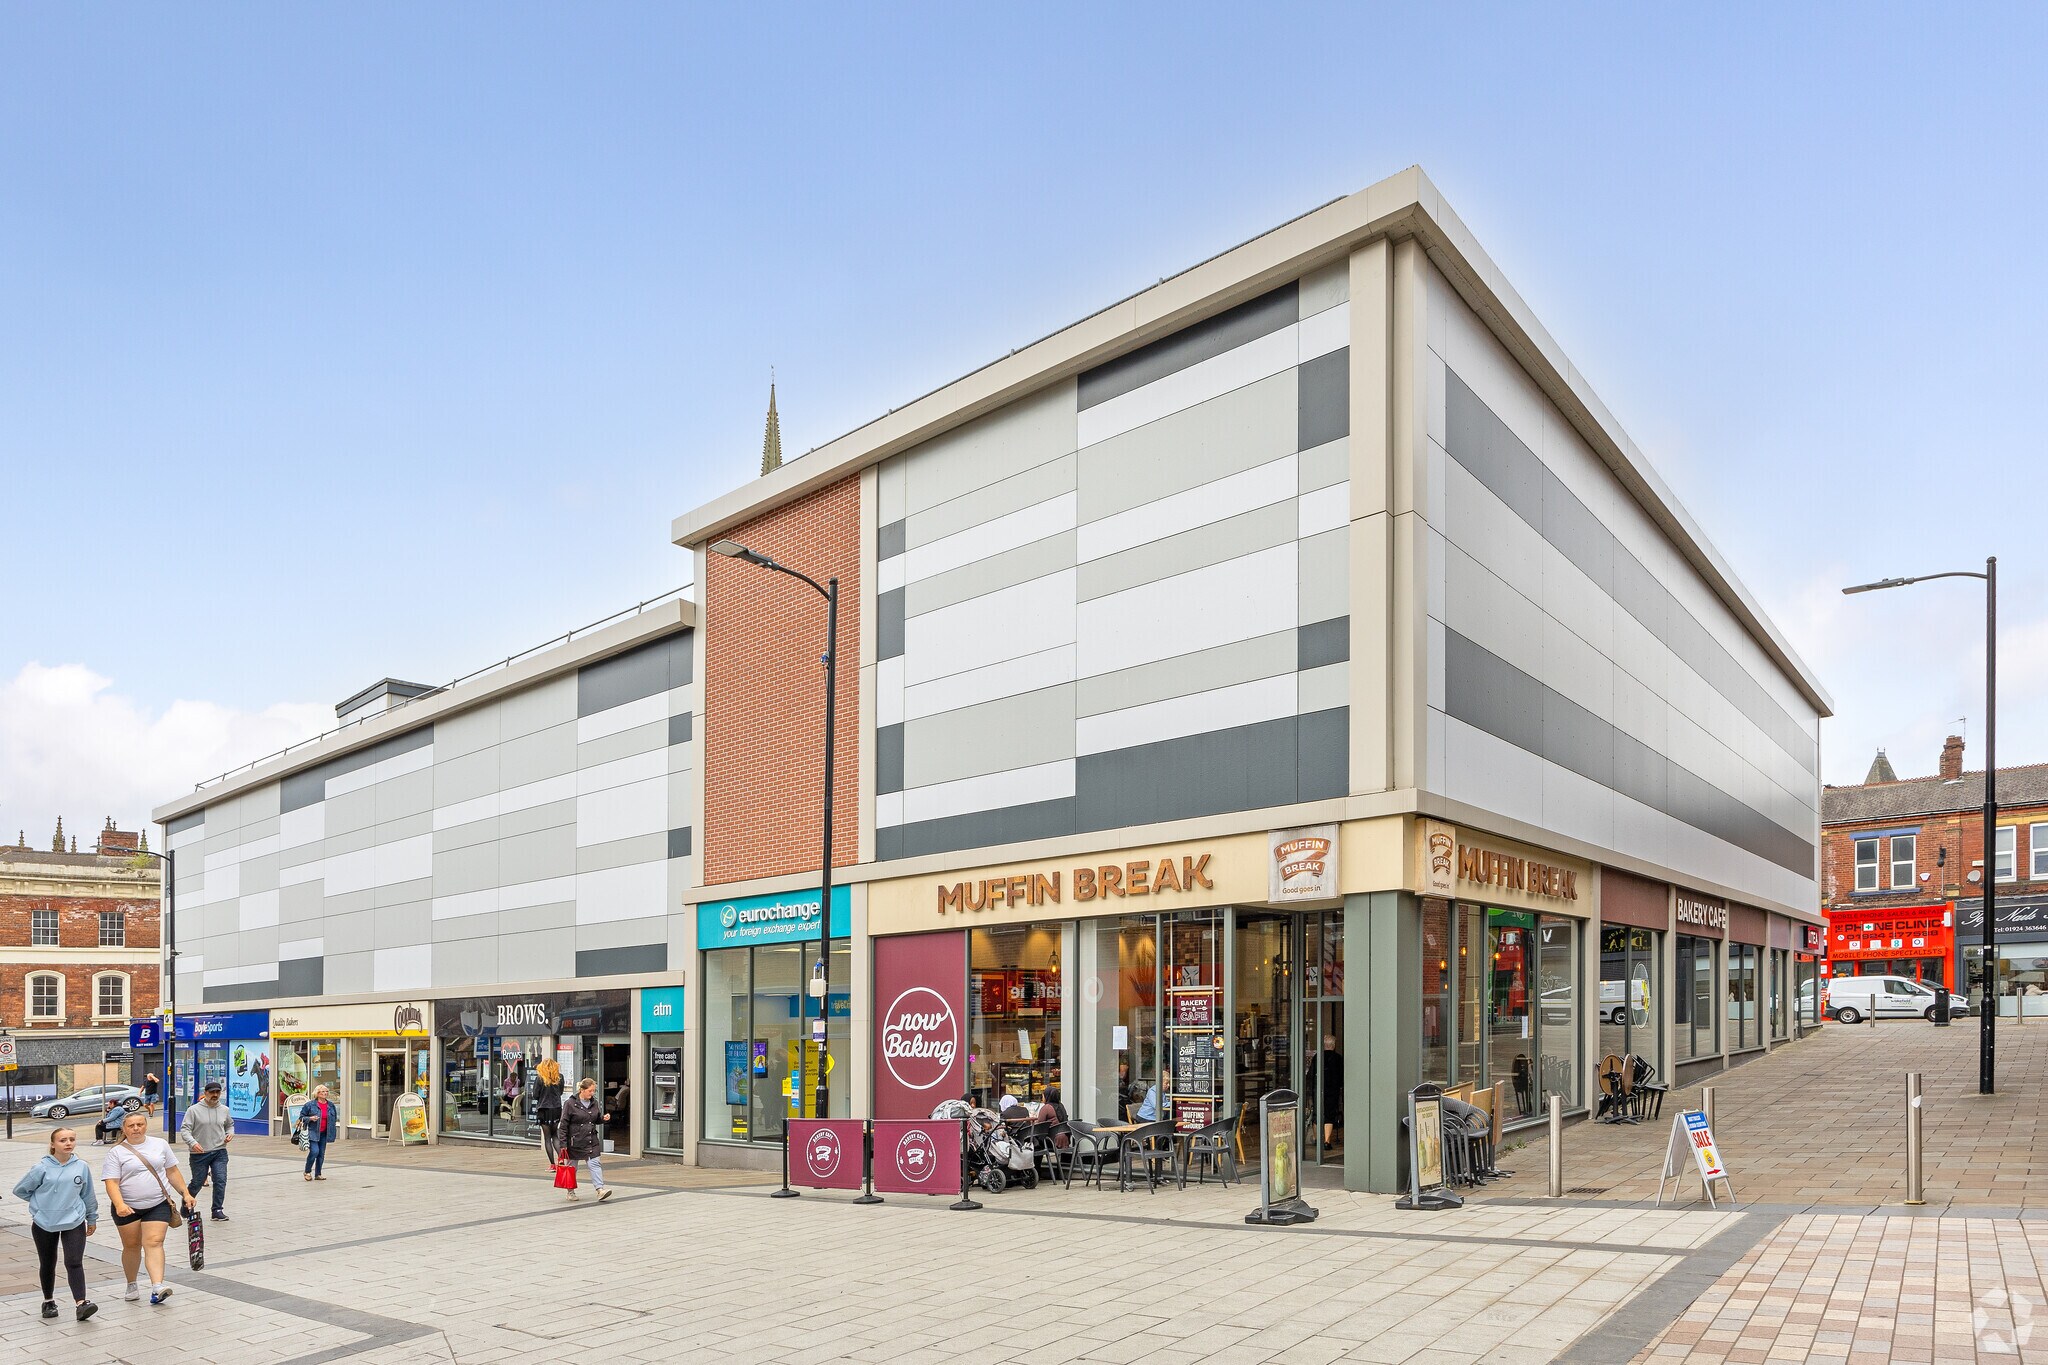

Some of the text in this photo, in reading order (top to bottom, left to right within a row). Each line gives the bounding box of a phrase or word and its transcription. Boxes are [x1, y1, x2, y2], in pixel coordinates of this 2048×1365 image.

[1280, 840, 1324, 854] MUFFIN
[1431, 836, 1451, 847] MUFFIN
[1285, 863, 1320, 874] BREAK
[1433, 857, 1450, 866] BREAK
[1457, 844, 1578, 900] MUFFIN BREAK
[937, 854, 1214, 915] MUFFIN BREAK
[1282, 886, 1298, 894] Good
[1299, 886, 1313, 894] goes
[738, 901, 821, 924] eurochange
[1677, 898, 1727, 929] BAKERY CAFE
[1995, 906, 2039, 922] Nails
[723, 920, 821, 940] your foreign exchange expert
[1895, 919, 1941, 929] CLINIC
[1891, 949, 1943, 957] SPECIALISTS
[497, 1003, 549, 1025] BROWS.
[653, 1002, 672, 1016] atm
[272, 1017, 299, 1029] Quality Bakers
[893, 1011, 946, 1031] now
[1180, 1011, 1208, 1022] CAFE
[140, 1028, 151, 1038] B
[194, 1020, 223, 1034] BoyleSports
[502, 1049, 522, 1061] Brows
[887, 1033, 954, 1066] Baking
[1182, 1111, 1205, 1119] MUFFINS
[1692, 1130, 1713, 1149] SALE
